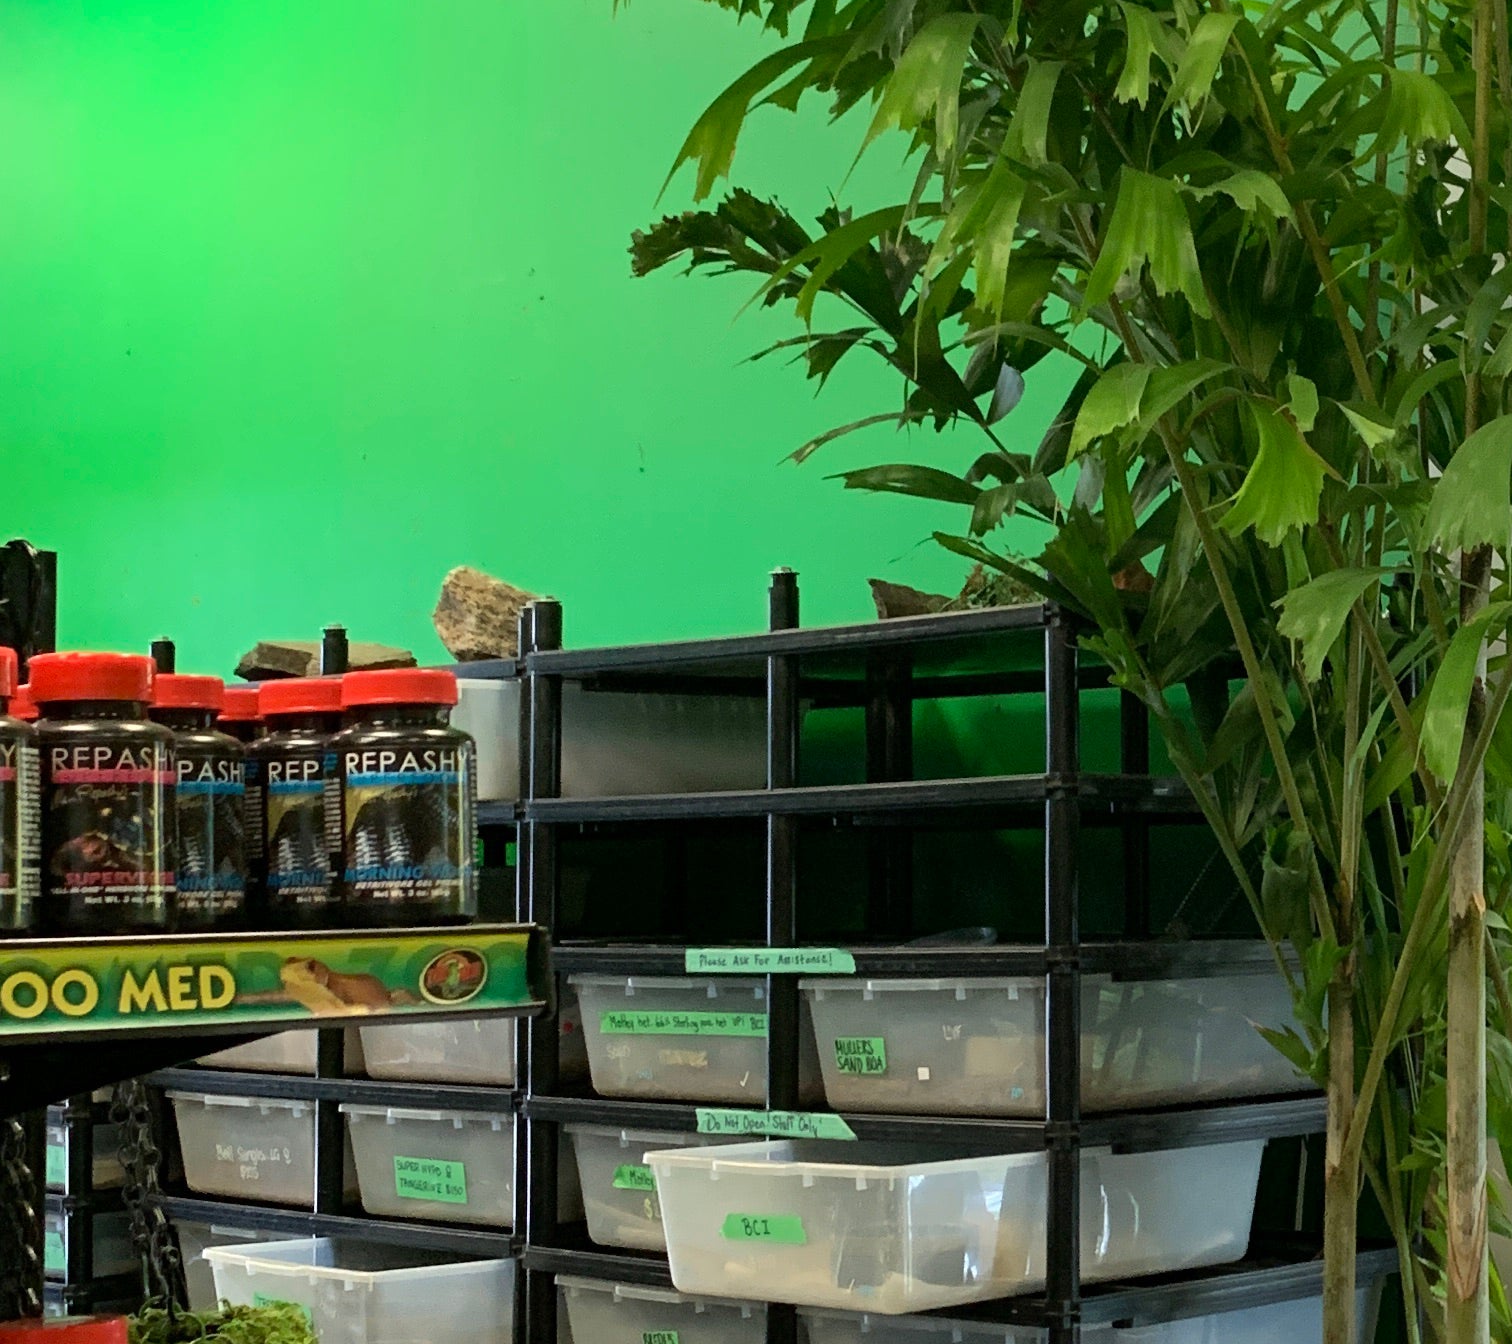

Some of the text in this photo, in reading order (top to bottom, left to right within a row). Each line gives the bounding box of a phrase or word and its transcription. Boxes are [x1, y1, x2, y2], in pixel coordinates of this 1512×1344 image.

[52, 746, 178, 772] REPASHY
[345, 751, 468, 776] REPASHY
[699, 954, 727, 967] Please
[733, 955, 749, 966] Ask
[754, 954, 770, 966] For
[0, 965, 236, 1019] OO MED
[838, 1057, 883, 1073] SAND BOA
[724, 1114, 739, 1127] Not
[741, 1217, 771, 1236] BCI
